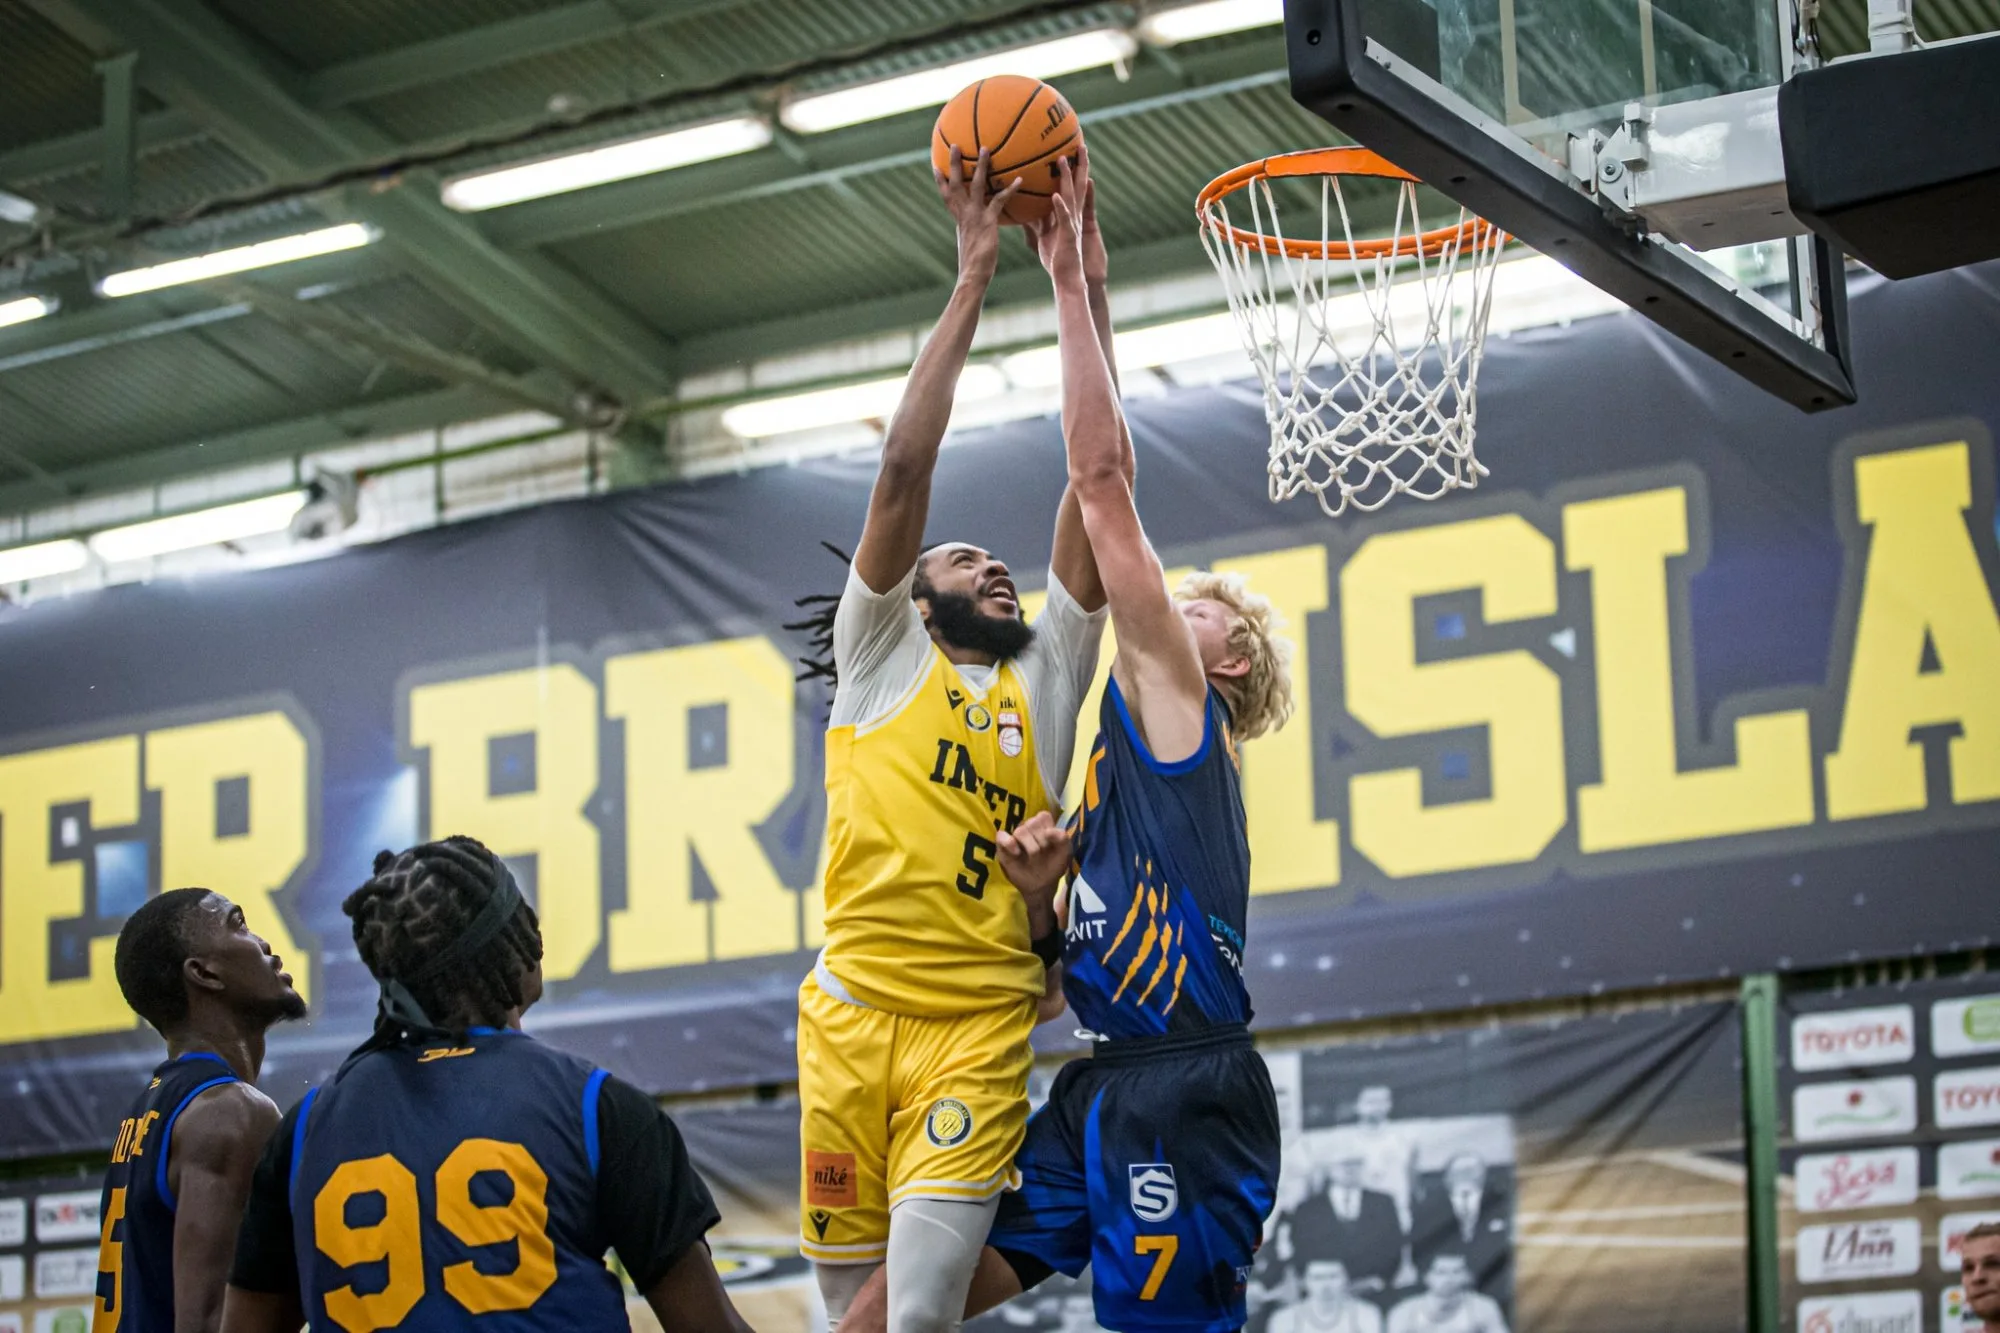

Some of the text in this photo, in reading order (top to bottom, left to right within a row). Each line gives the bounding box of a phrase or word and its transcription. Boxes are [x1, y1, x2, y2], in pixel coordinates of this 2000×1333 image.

[410, 440, 2000, 982] BRISLA
[929, 738, 1027, 835] INER
[956, 831, 998, 901] 5
[1070, 919, 1107, 942] VIT
[1802, 1023, 1905, 1053] TOYOTA
[1944, 1085, 2000, 1112] TOY
[814, 1166, 848, 1186] niké
[314, 1137, 558, 1333] 99
[1134, 1235, 1179, 1300] 7
